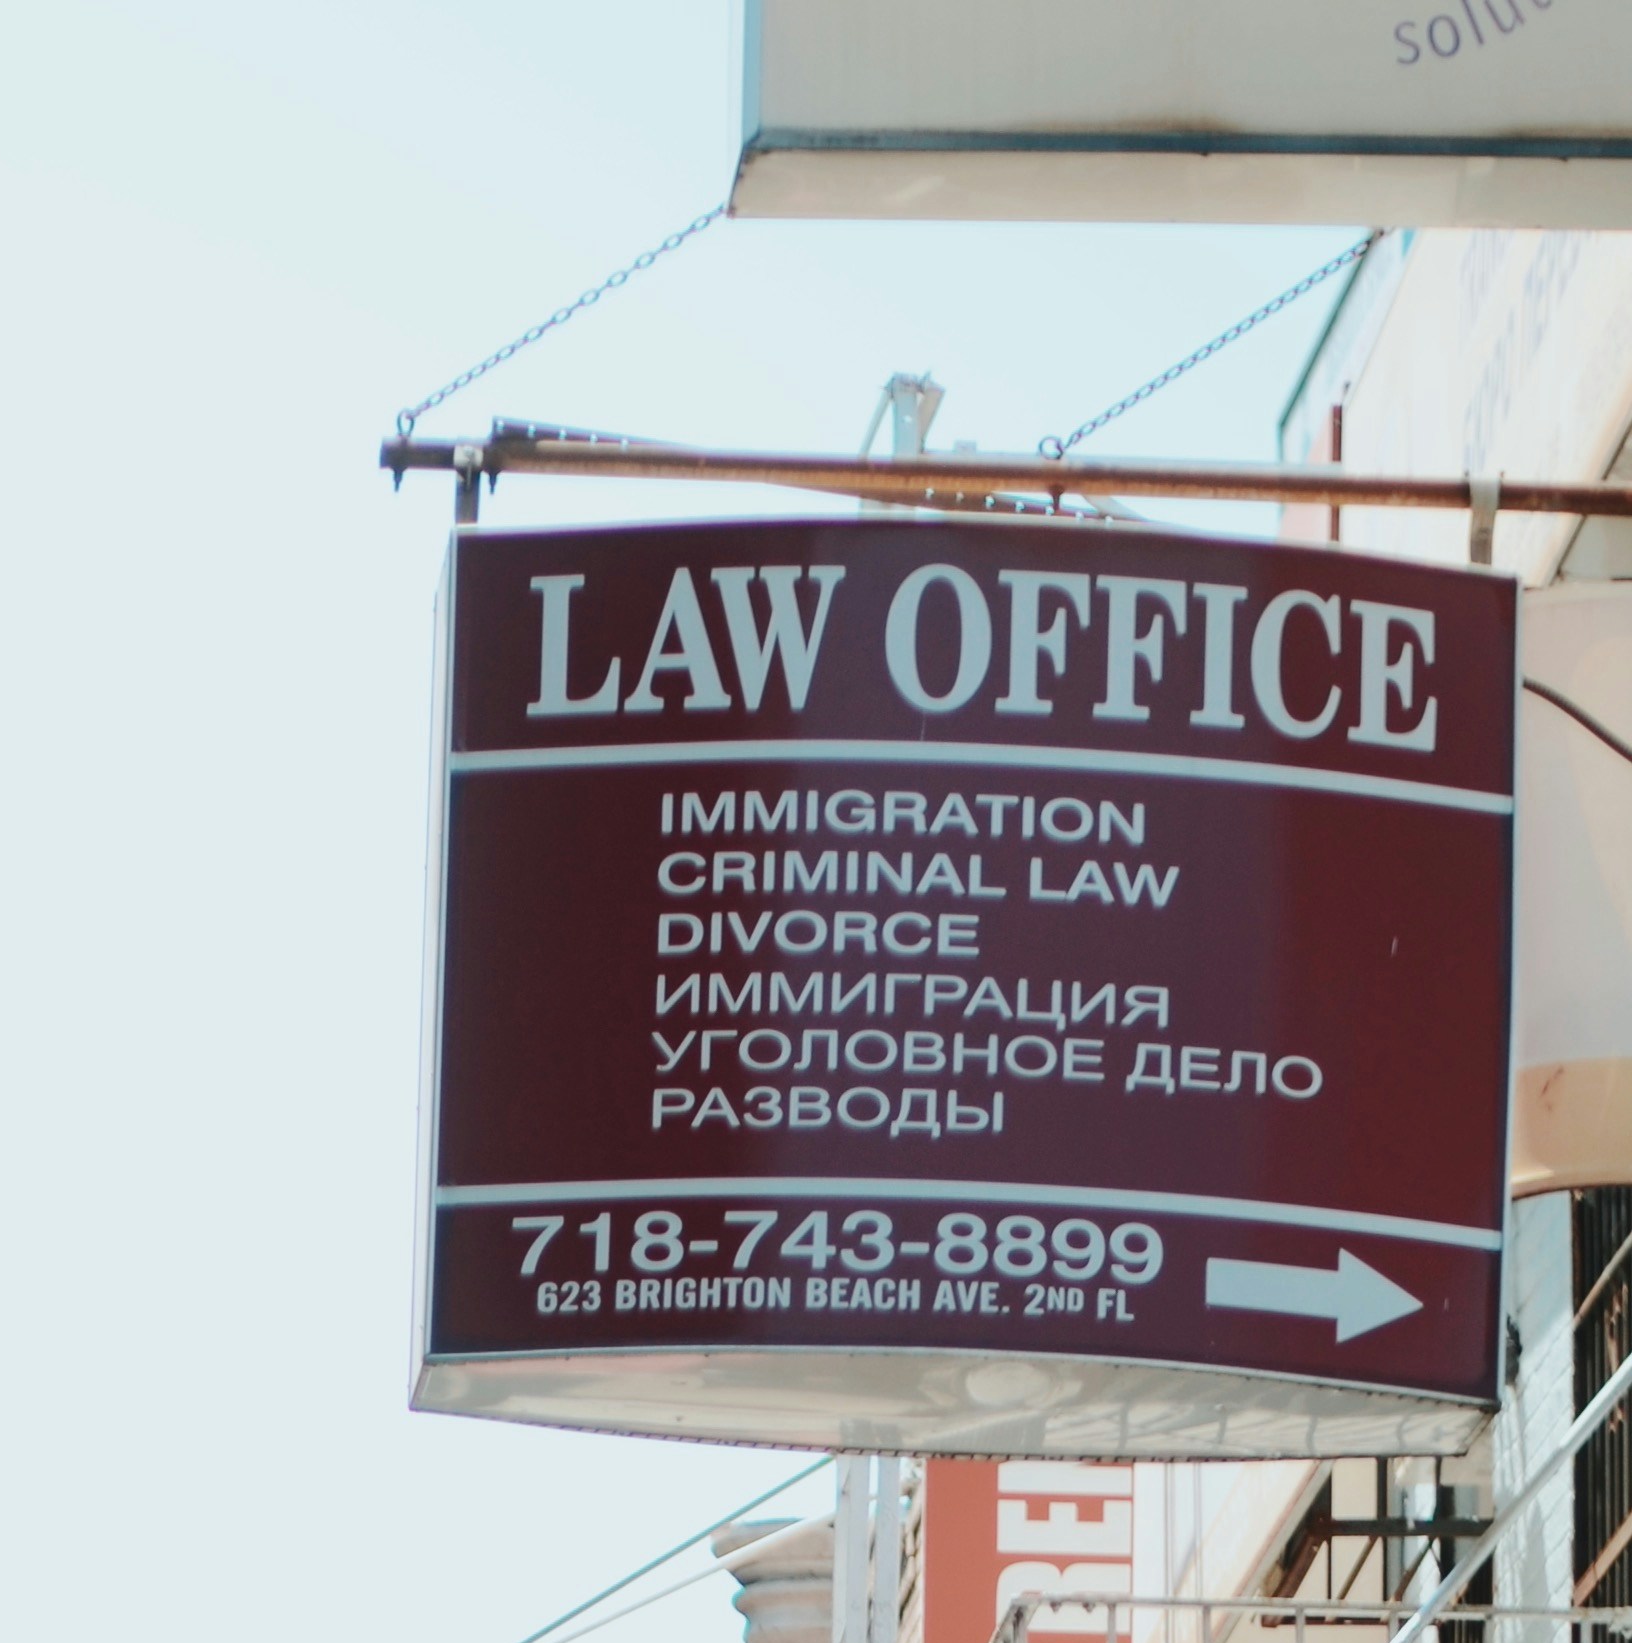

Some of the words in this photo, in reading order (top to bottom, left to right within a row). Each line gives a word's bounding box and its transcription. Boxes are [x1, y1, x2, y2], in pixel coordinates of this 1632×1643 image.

[1394, 0, 1552, 64] solu
[527, 565, 846, 717] LAW
[884, 563, 1439, 752] OFFICE
[661, 789, 1145, 845] IMMIGRATION
[657, 851, 1006, 898] CRIMINAL
[1029, 858, 1180, 906] LAW
[657, 911, 980, 956] DIVORCE
[654, 973, 1169, 1032] ИММИГРАЦИЯ
[652, 1028, 1105, 1080] УГОЛОВНОЕ
[1126, 1045, 1323, 1098] ДЕЛО
[652, 1087, 1004, 1138] РАЗВОДЫ
[511, 1210, 1164, 1284] 718-743-8899
[537, 1281, 602, 1315] 623
[615, 1277, 791, 1312] BRIGHTON
[805, 1277, 921, 1313] BEACH
[934, 1280, 1010, 1317] AVE.
[1024, 1284, 1085, 1317] 2ND
[1097, 1287, 1135, 1322] FL
